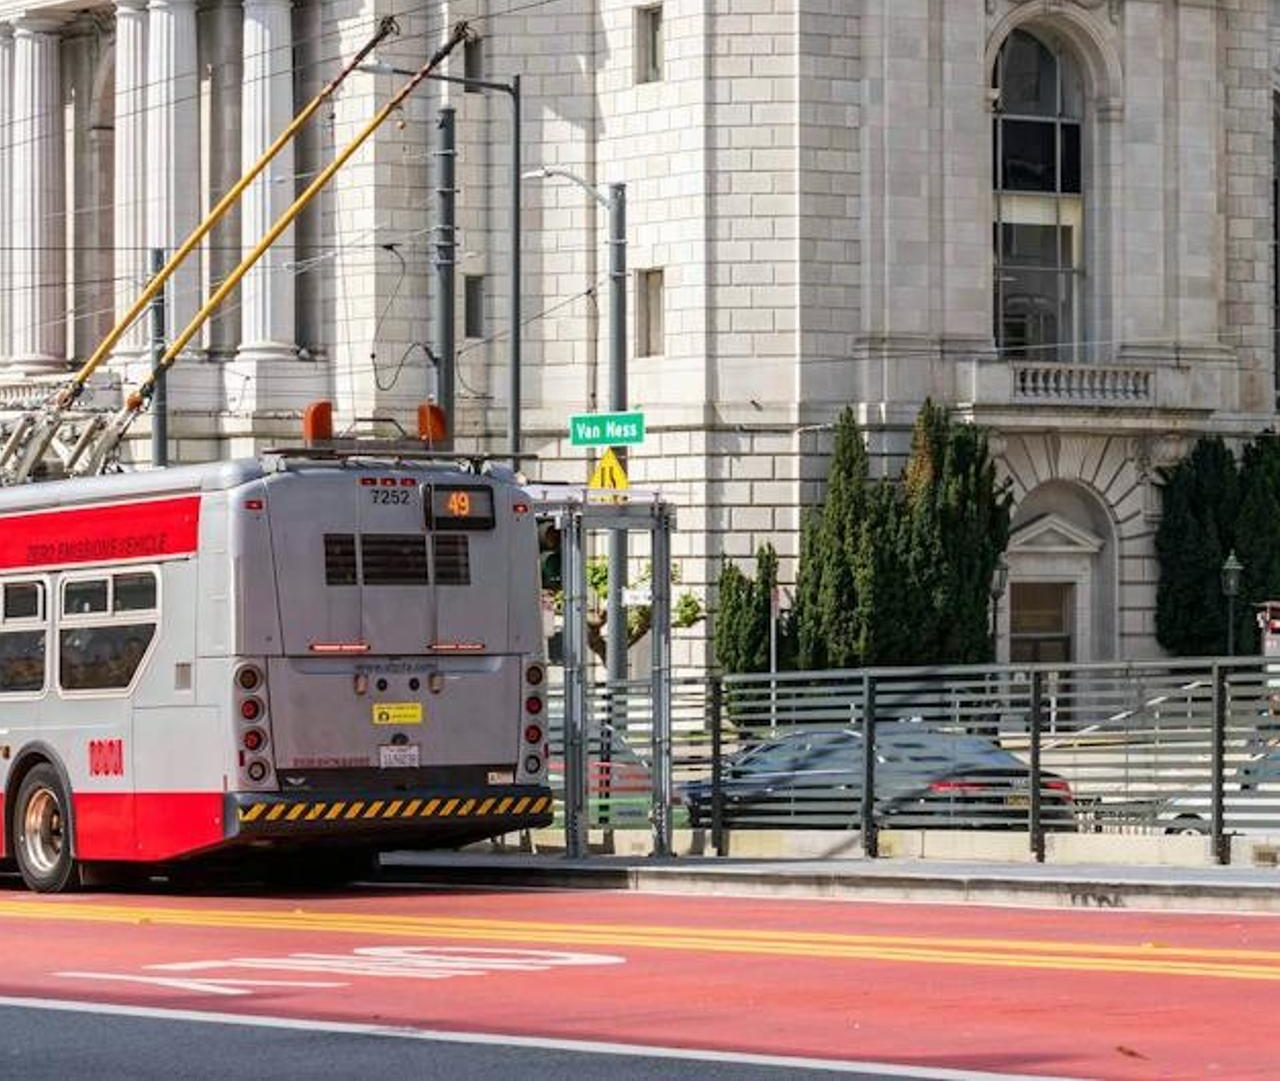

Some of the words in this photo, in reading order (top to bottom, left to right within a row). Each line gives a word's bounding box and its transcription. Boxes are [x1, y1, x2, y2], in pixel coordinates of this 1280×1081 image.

[576, 422, 601, 439] Van
[605, 422, 638, 438] Ness
[370, 489, 410, 506] 7252
[447, 490, 470, 517] 49
